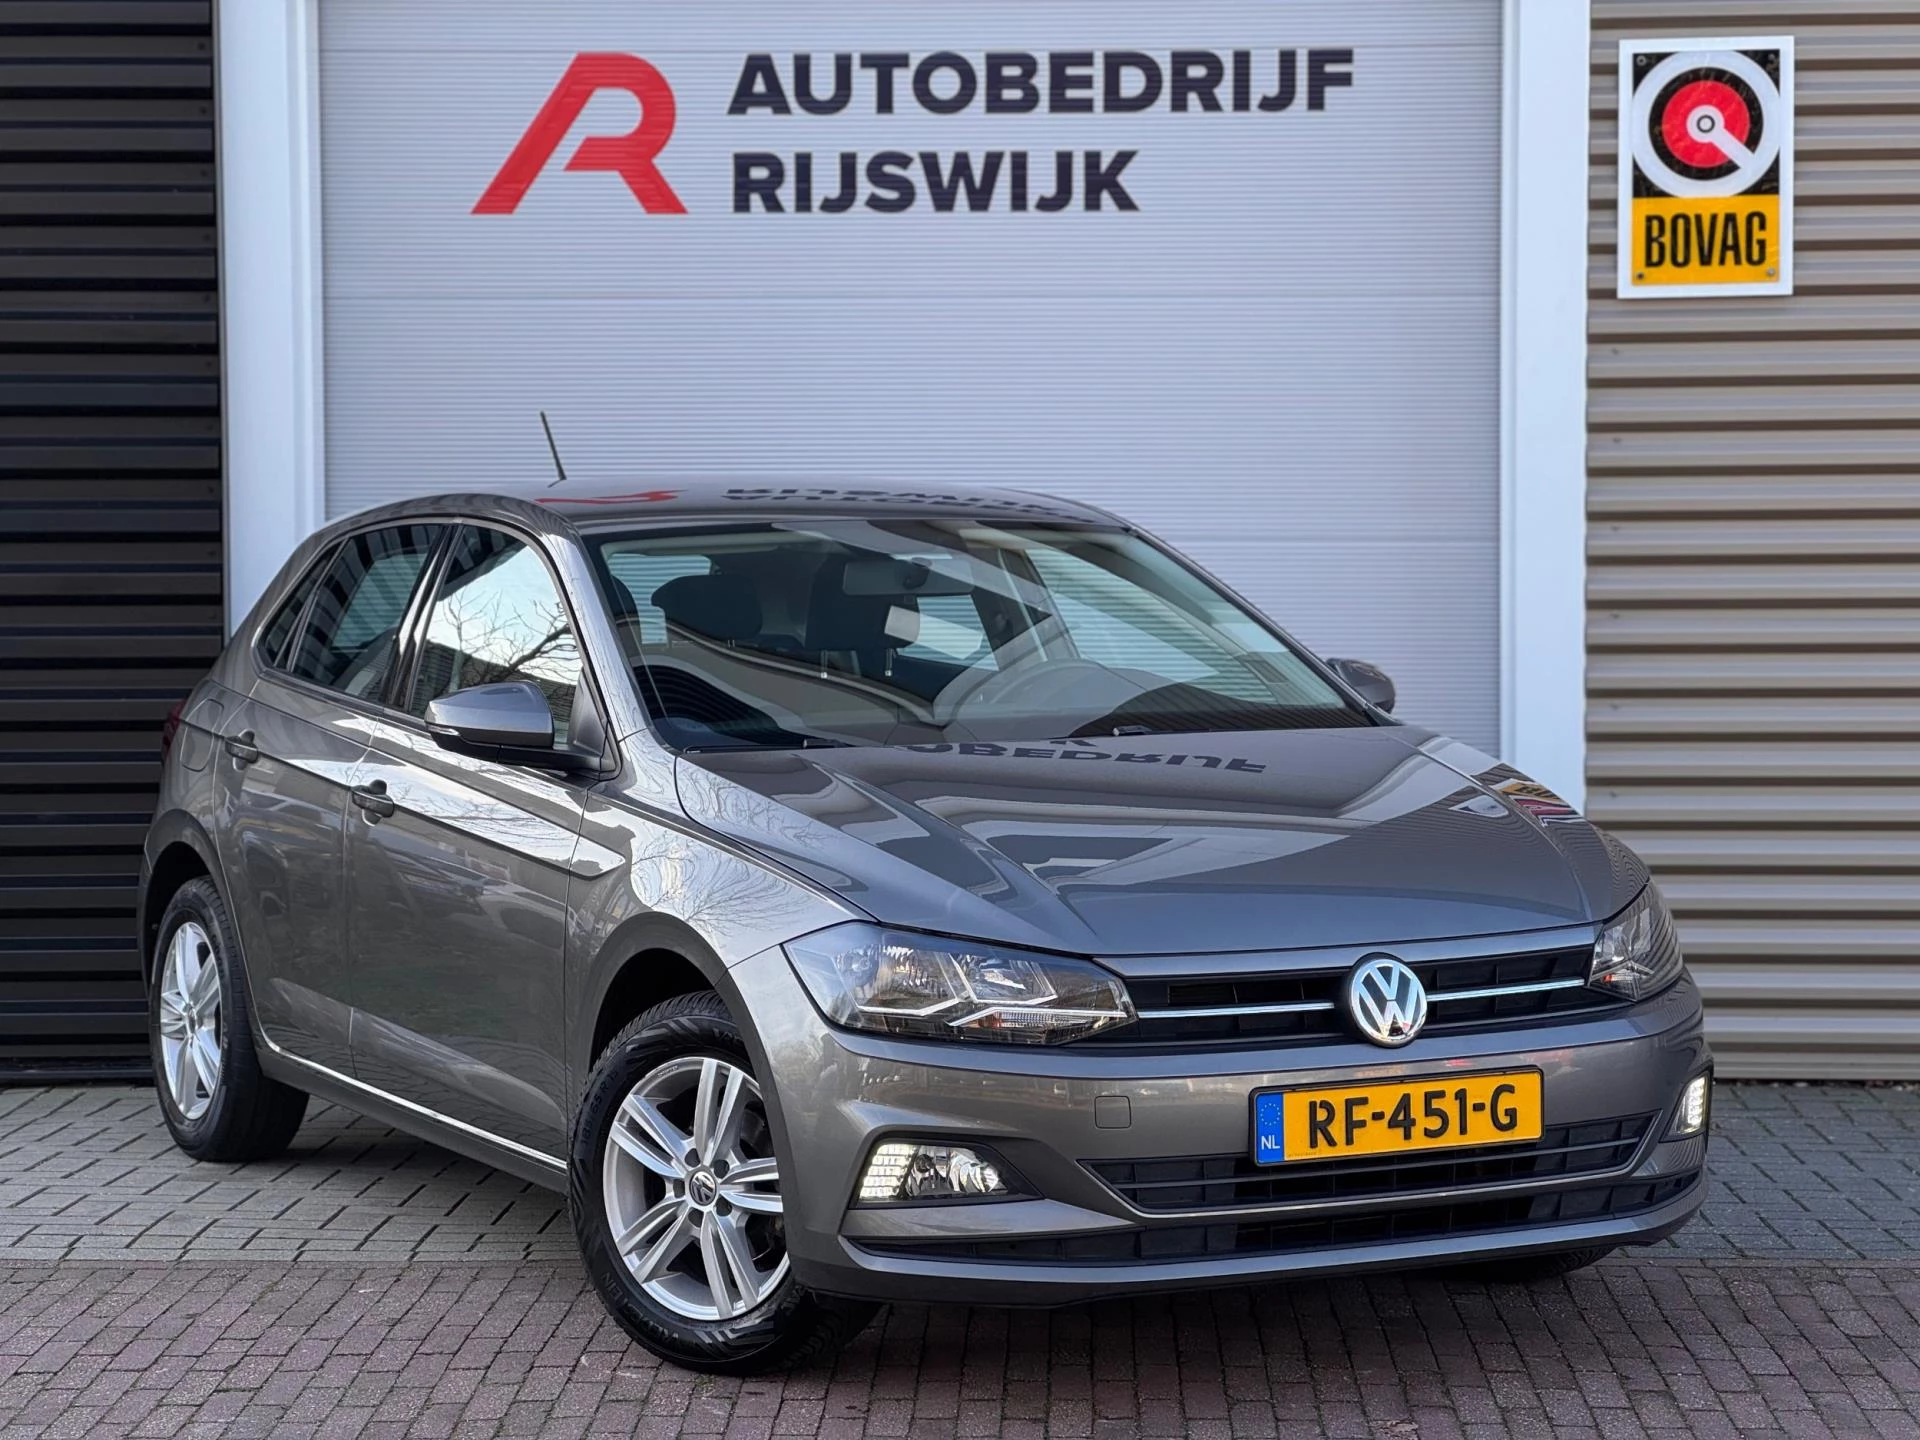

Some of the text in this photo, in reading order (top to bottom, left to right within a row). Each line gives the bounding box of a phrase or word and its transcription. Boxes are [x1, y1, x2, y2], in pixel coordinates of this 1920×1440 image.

[727, 48, 1354, 116] AUTOBEDRIJF
[732, 150, 1139, 214] RIJSWIJK
[1644, 210, 1767, 269] BOVAG
[1261, 1135, 1281, 1150] NL
[1308, 1083, 1518, 1150] RF-451-G
